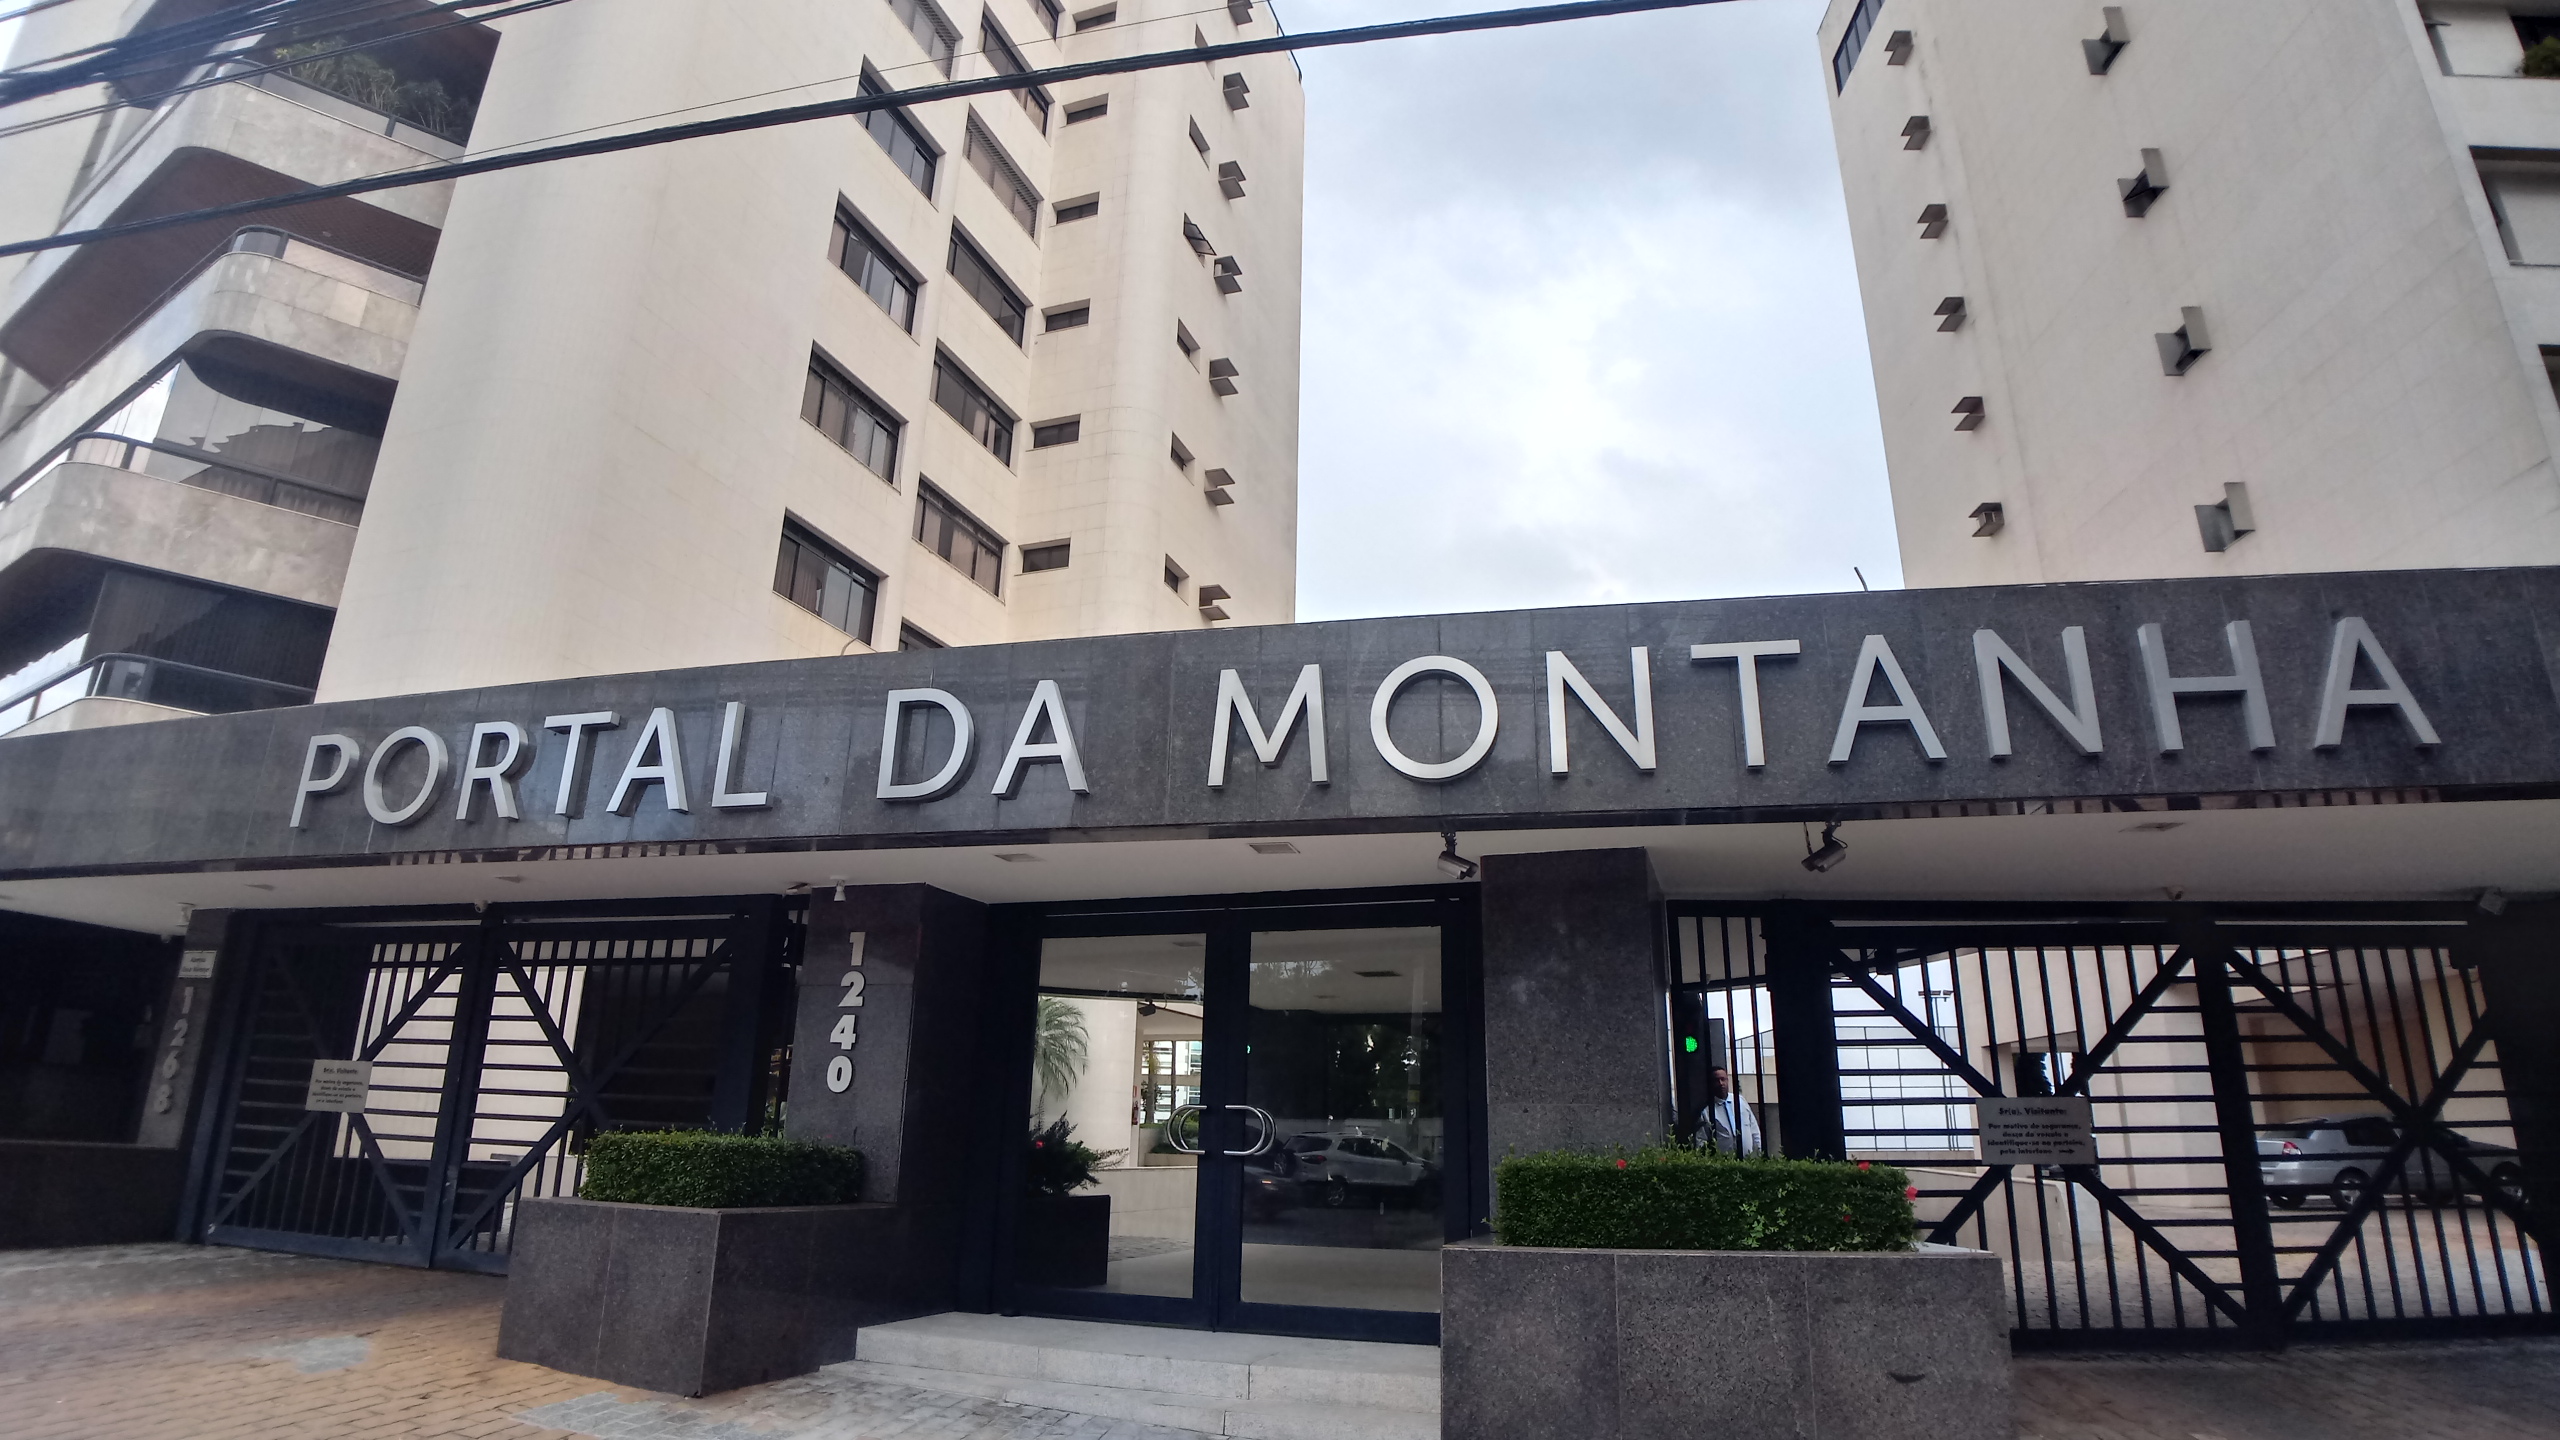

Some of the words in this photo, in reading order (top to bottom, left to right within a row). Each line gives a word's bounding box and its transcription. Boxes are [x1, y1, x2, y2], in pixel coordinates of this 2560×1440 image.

[289, 701, 769, 828] PORTAL
[876, 680, 1089, 799] DA
[1207, 616, 2443, 789] MONTANHA
[154, 986, 194, 1114] 1268
[826, 931, 866, 1093] 1240
